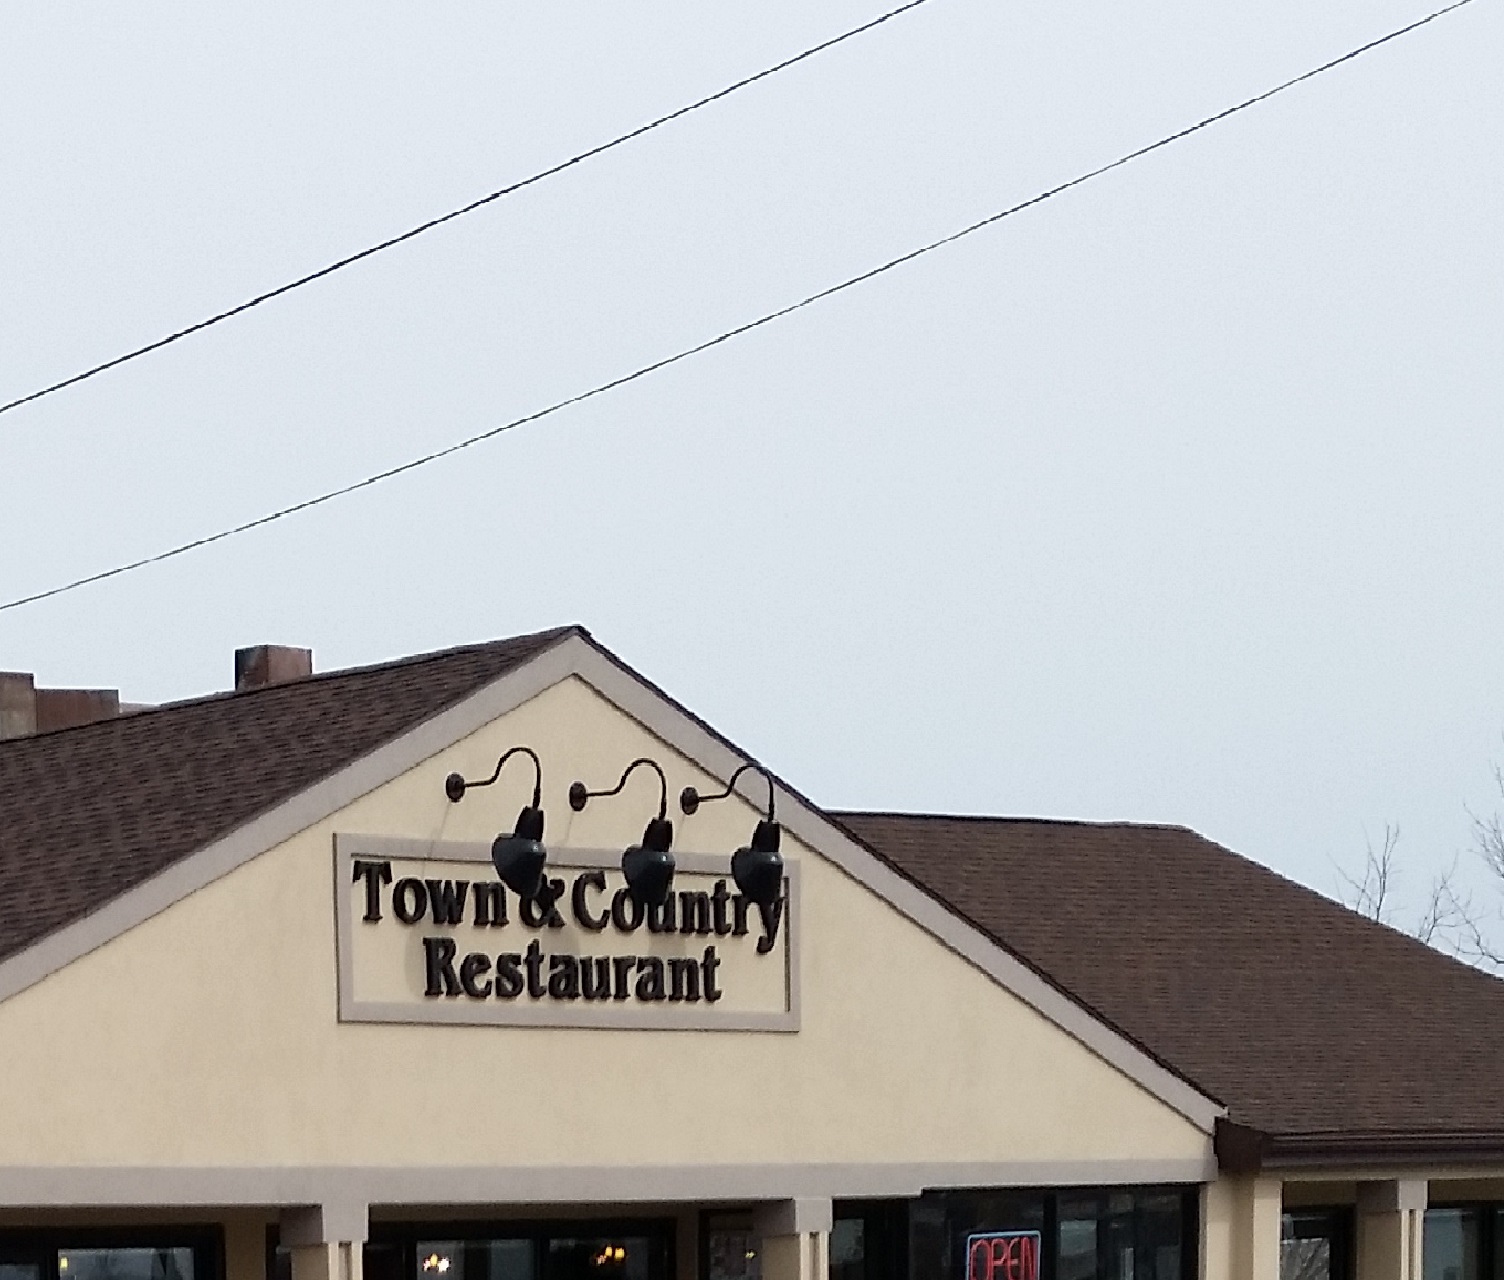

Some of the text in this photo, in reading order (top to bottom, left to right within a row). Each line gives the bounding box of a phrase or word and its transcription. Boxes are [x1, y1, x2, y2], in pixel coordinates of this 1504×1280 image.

[353, 861, 510, 926] Town
[572, 871, 784, 953] Country
[423, 936, 722, 1002] Restaurant
